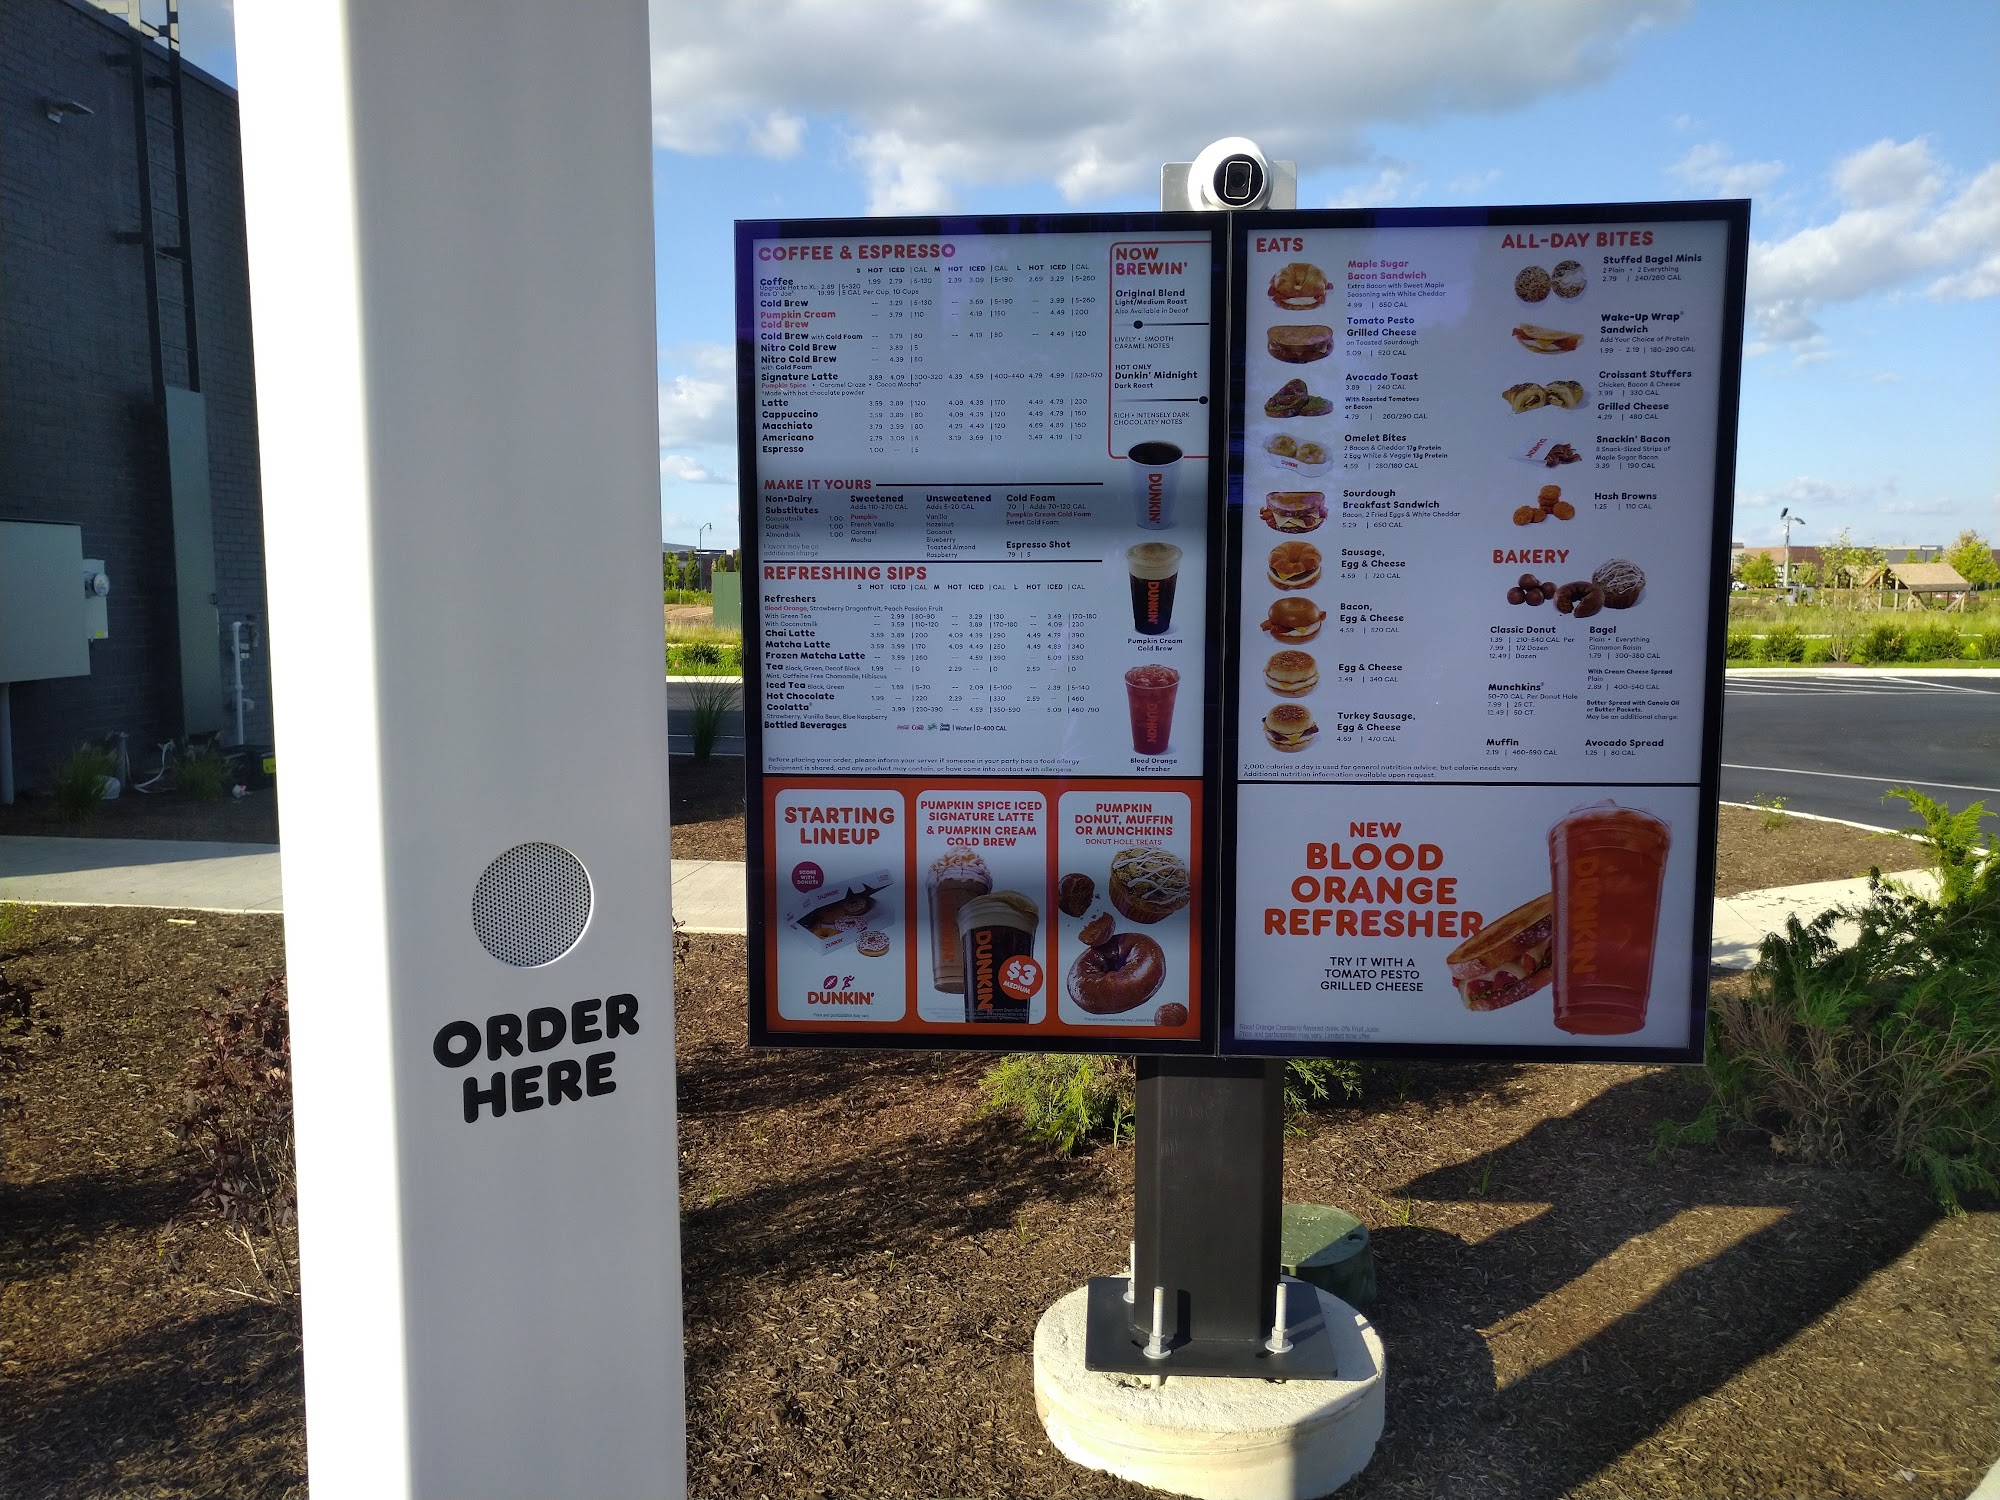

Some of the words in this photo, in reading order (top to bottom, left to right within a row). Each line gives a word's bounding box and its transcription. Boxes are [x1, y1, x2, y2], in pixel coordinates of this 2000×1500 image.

[1257, 238, 1303, 252] EATS
[1502, 232, 1590, 248] ALL-DAY
[1597, 231, 1653, 247] BITES
[758, 246, 833, 261] COFFEE
[840, 245, 852, 259] &
[859, 244, 955, 259] ESPRESSO
[1116, 247, 1159, 260] NOW
[1348, 259, 1377, 270] Maple
[1381, 259, 1409, 270] Sugar
[1604, 254, 1642, 265] Stuffed
[1645, 254, 1672, 266] Bagel
[1676, 253, 1701, 263] Minis
[1116, 262, 1187, 275] BREWIN'
[1609, 266, 1624, 274] Plain
[1643, 265, 1678, 274] Everything
[1348, 271, 1377, 281] Bacon
[1380, 270, 1426, 280] Sandwich
[1603, 275, 1617, 283] 2.79
[760, 277, 794, 287] Coffee
[1116, 288, 1155, 300] Original
[1159, 288, 1185, 297] Blend
[761, 299, 781, 308] Cold
[785, 299, 808, 308] Brew
[1115, 298, 1164, 307] Light/Medium
[760, 310, 801, 321] Pumpkin
[804, 310, 835, 319] Cream
[1347, 316, 1384, 325] Tomato
[1388, 316, 1414, 325] Pesto
[1601, 313, 1648, 324] Wake-Up
[761, 320, 782, 329] Cold
[785, 320, 808, 329] Brew
[1601, 324, 1648, 334] Sandwich
[1347, 328, 1378, 337] Grilled
[1382, 327, 1416, 337] Cheese
[761, 343, 785, 352] Nitro
[789, 343, 809, 352] Cold
[813, 343, 836, 352] Brew
[762, 372, 808, 384] Signature
[812, 372, 838, 381] Latte
[1115, 371, 1150, 380] Dunkin'
[1154, 370, 1197, 381] Midnight
[1346, 372, 1387, 382] Avocado
[1391, 372, 1418, 381] Toast
[1599, 370, 1647, 379] Croissant
[1650, 369, 1691, 379] Stuffers
[762, 398, 788, 407] Latte
[762, 410, 818, 421] Cappuccino
[762, 421, 812, 430] Macchiato
[762, 433, 813, 442] Americano
[1345, 433, 1379, 442] Omelet
[1383, 433, 1406, 442] Bites
[1597, 434, 1637, 444] Snackin'
[1641, 435, 1670, 443] Bacon
[763, 445, 803, 455] Espresso
[764, 479, 803, 491] MAKE
[808, 479, 820, 490] IT
[825, 479, 871, 490] YOURS
[851, 494, 903, 503] Sweetened
[927, 493, 991, 503] Unsweetened
[1007, 493, 1027, 502] Cold
[1030, 493, 1055, 502] Foam
[1343, 488, 1395, 499] Sourdough
[1595, 491, 1618, 500] Hash
[1622, 492, 1656, 501] Browns
[766, 505, 818, 514] Substitutes
[1343, 500, 1390, 509] Breakfast
[1394, 500, 1439, 509] Sandwich
[1007, 540, 1046, 551] Espresso
[1049, 540, 1070, 549] Shot
[1342, 548, 1384, 558] Sausage,
[1493, 550, 1569, 563] BAKERY
[1342, 560, 1358, 570] Egg
[1362, 559, 1368, 568] &
[1371, 559, 1405, 568] Cheese
[764, 566, 880, 580] REFRESHING
[887, 566, 926, 580] SIPS
[890, 583, 905, 591] ICED
[765, 594, 816, 603] Refreshers
[1341, 602, 1372, 612] Bacon,
[765, 629, 786, 637] Chai
[789, 629, 815, 637] Latte
[1491, 625, 1523, 634] Classic
[1527, 625, 1556, 634] Donut
[1590, 625, 1616, 636] Bagel
[766, 651, 797, 660] Frozen
[801, 651, 836, 660] Matcha
[839, 651, 865, 660] Latte
[766, 662, 783, 671] Tea
[1339, 663, 1356, 674] Egg
[1359, 663, 1365, 671] &
[1368, 663, 1402, 671] Cheese
[767, 681, 785, 689] Iced
[788, 681, 805, 689] Tea
[767, 692, 783, 700] Hot
[786, 692, 834, 700] Chocolate
[1338, 711, 1370, 722] Turkey
[1373, 712, 1415, 722] Sausage,
[764, 720, 797, 729] Bottled
[800, 721, 846, 731] Beverages
[1486, 738, 1518, 746] Muffin
[1585, 738, 1626, 747] Avocado
[1630, 738, 1663, 749] Spread
[921, 800, 973, 810] PUMPKIN
[978, 800, 1011, 811] SPICE
[1015, 801, 1042, 811] ICED
[1096, 803, 1151, 813] PUMPKIN
[785, 807, 894, 824] STARTING
[929, 811, 994, 822] SIGNATURE
[998, 812, 1034, 822] LATTE
[1075, 814, 1121, 826] DONUT,
[1126, 814, 1173, 825] MUFFIN
[927, 825, 934, 835] &
[938, 825, 991, 836] PUMPKIN
[995, 826, 1036, 836] CREAM
[1076, 825, 1092, 836] OR
[1096, 825, 1172, 836] MUNCHKINS
[1350, 822, 1401, 838] NEW
[800, 828, 879, 845] LINEUP
[947, 836, 979, 847] COLD
[983, 837, 1016, 847] BREW
[1113, 837, 1134, 846] HOLE
[1136, 838, 1162, 847] TREATS
[1307, 843, 1443, 871] BLOOD
[1291, 876, 1457, 904] ORANGE
[1265, 908, 1483, 938] REFRESHER
[1330, 956, 1352, 967] TRY
[1357, 956, 1367, 967] IT
[1371, 957, 1402, 968] WITH
[1407, 957, 1415, 968] A
[1007, 960, 1037, 986] $3
[1325, 968, 1376, 979] TOMATO
[1381, 969, 1419, 980] PESTO
[1003, 980, 1031, 995] MEDIUM
[1321, 980, 1371, 991] GRILLED
[1376, 981, 1423, 992] CHEESE
[433, 993, 640, 1068] ORDER
[463, 1051, 617, 1124] HERE
